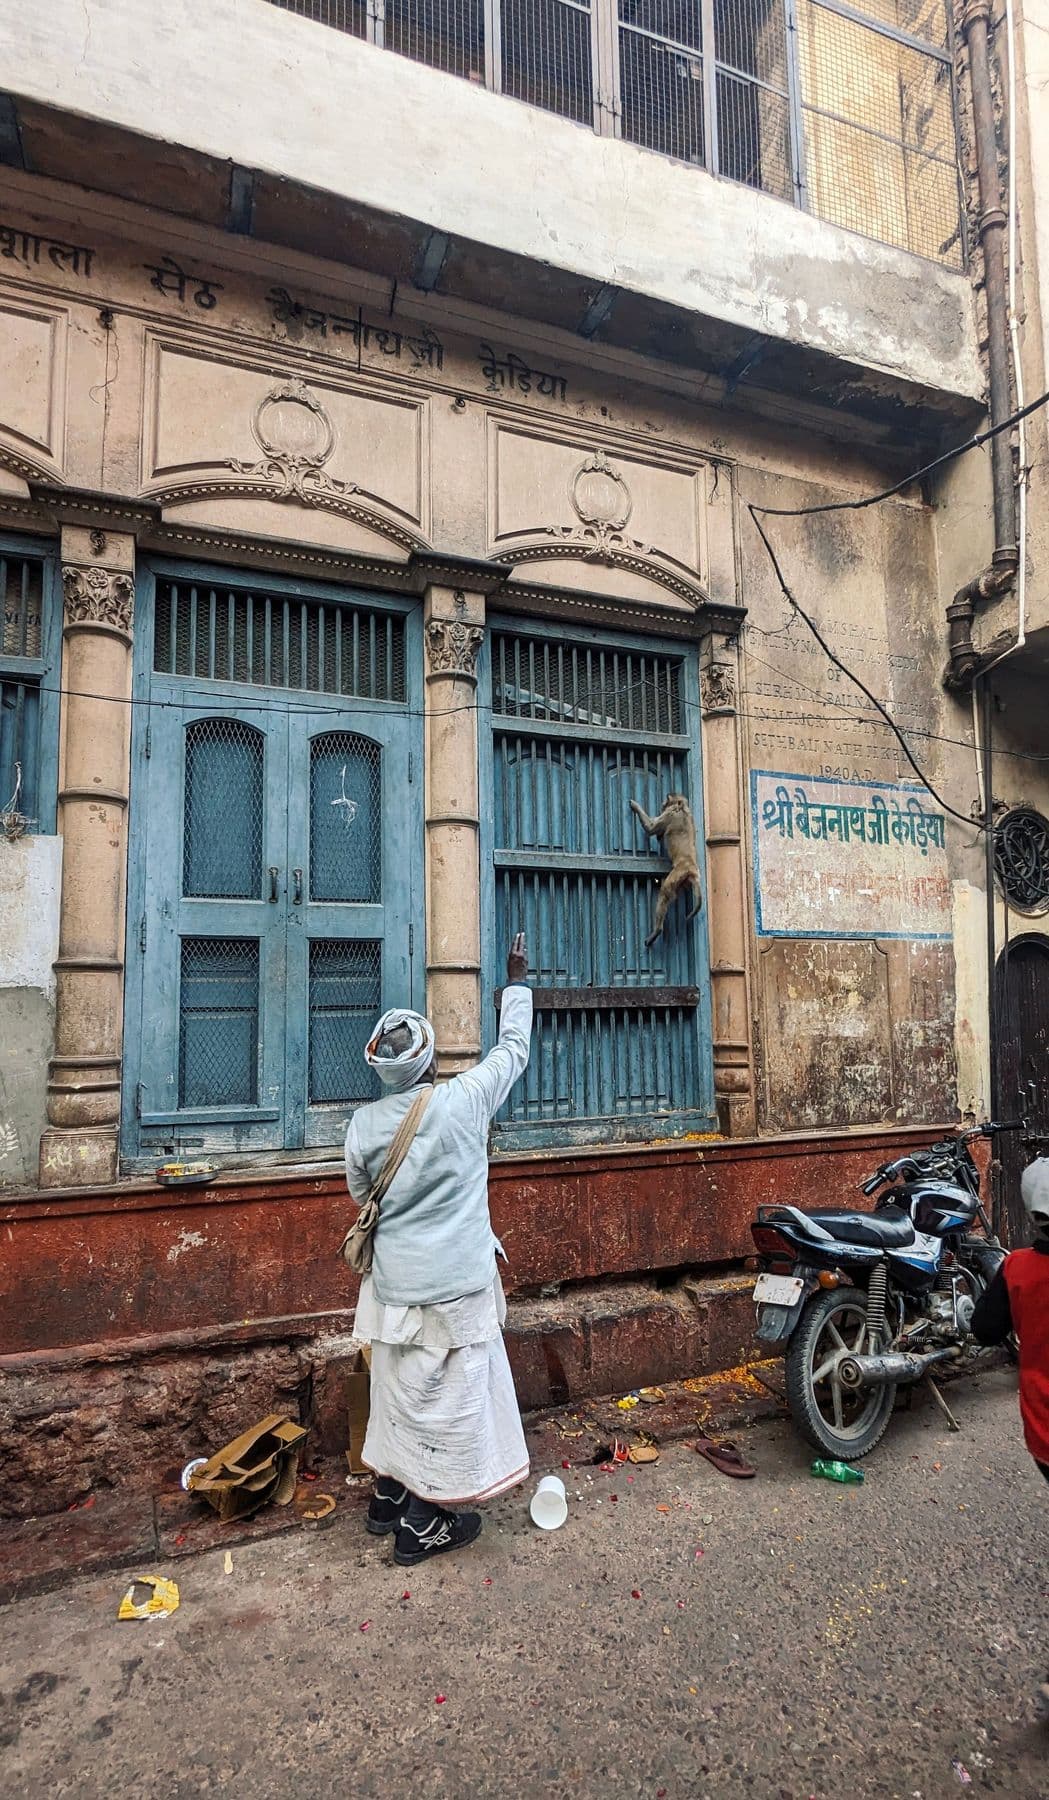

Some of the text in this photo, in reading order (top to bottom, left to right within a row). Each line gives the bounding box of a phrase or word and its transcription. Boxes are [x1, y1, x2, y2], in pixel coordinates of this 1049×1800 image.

[142, 255, 225, 310] सेठ
[826, 667, 842, 682] OF
[818, 764, 849, 781] 1940
[762, 785, 794, 840] श्री
